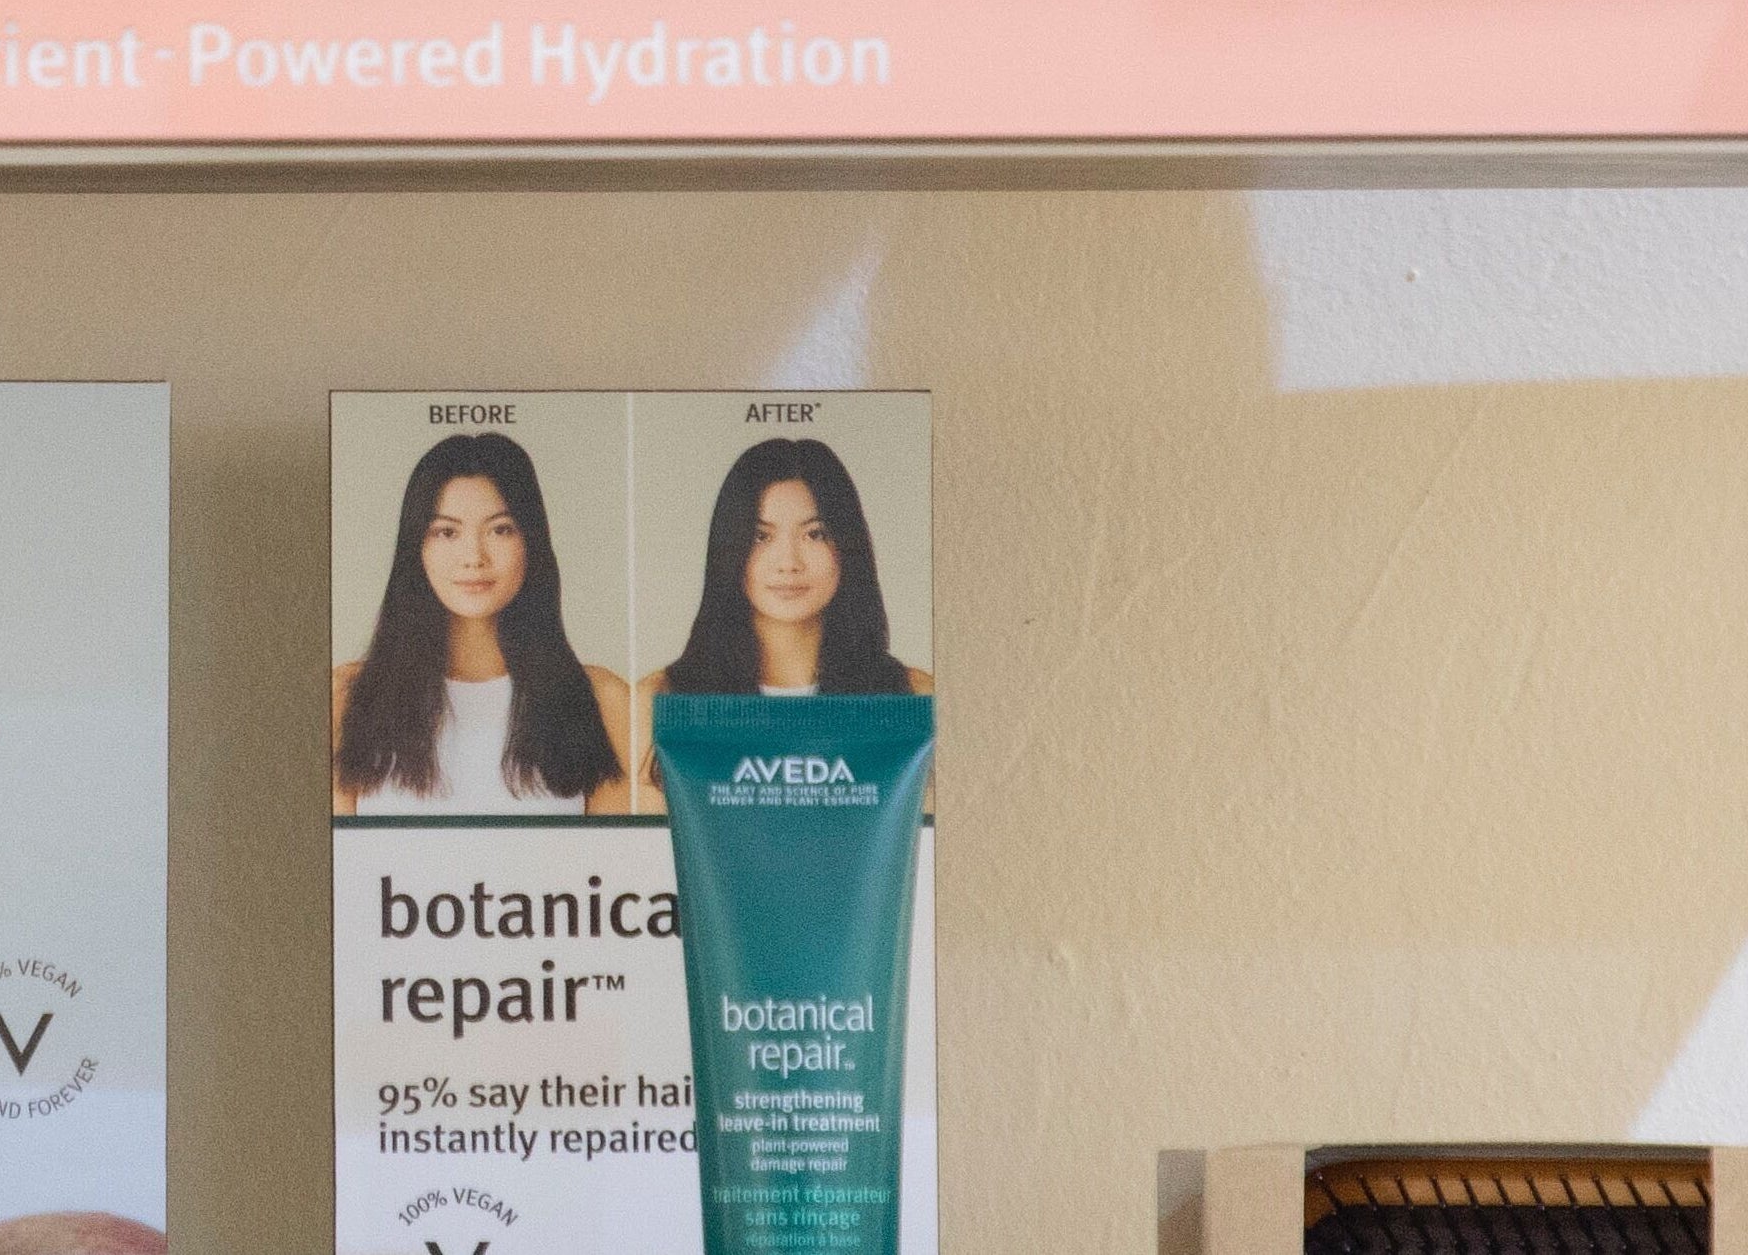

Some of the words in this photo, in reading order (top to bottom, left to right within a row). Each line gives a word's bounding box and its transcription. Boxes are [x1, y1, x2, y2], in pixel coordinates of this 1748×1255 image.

[531, 21, 892, 106] Hydration
[429, 405, 517, 424] BEFORE
[735, 758, 854, 783] AVEDA
[381, 875, 683, 939] botanica
[18, 959, 83, 998] VEGAN
[381, 960, 625, 1040] repair™
[723, 995, 874, 1032] botanical
[29, 1057, 99, 1119] FOREVER
[378, 1077, 457, 1115] 95%
[469, 1083, 529, 1114] say
[541, 1076, 625, 1107] their
[638, 1075, 692, 1107] hai
[735, 1092, 864, 1113] strengthening
[379, 1122, 537, 1161] instantly
[551, 1122, 697, 1161] repaired
[719, 1115, 787, 1132] leave-in
[794, 1116, 880, 1132] treatment
[752, 1139, 849, 1155] plant-powered
[752, 1159, 805, 1173] damage
[809, 1159, 848, 1173] repair
[398, 1190, 448, 1227] 100%
[453, 1188, 519, 1227] VEGAN
[746, 1211, 787, 1226] sans
[794, 1209, 860, 1229] rinçage
